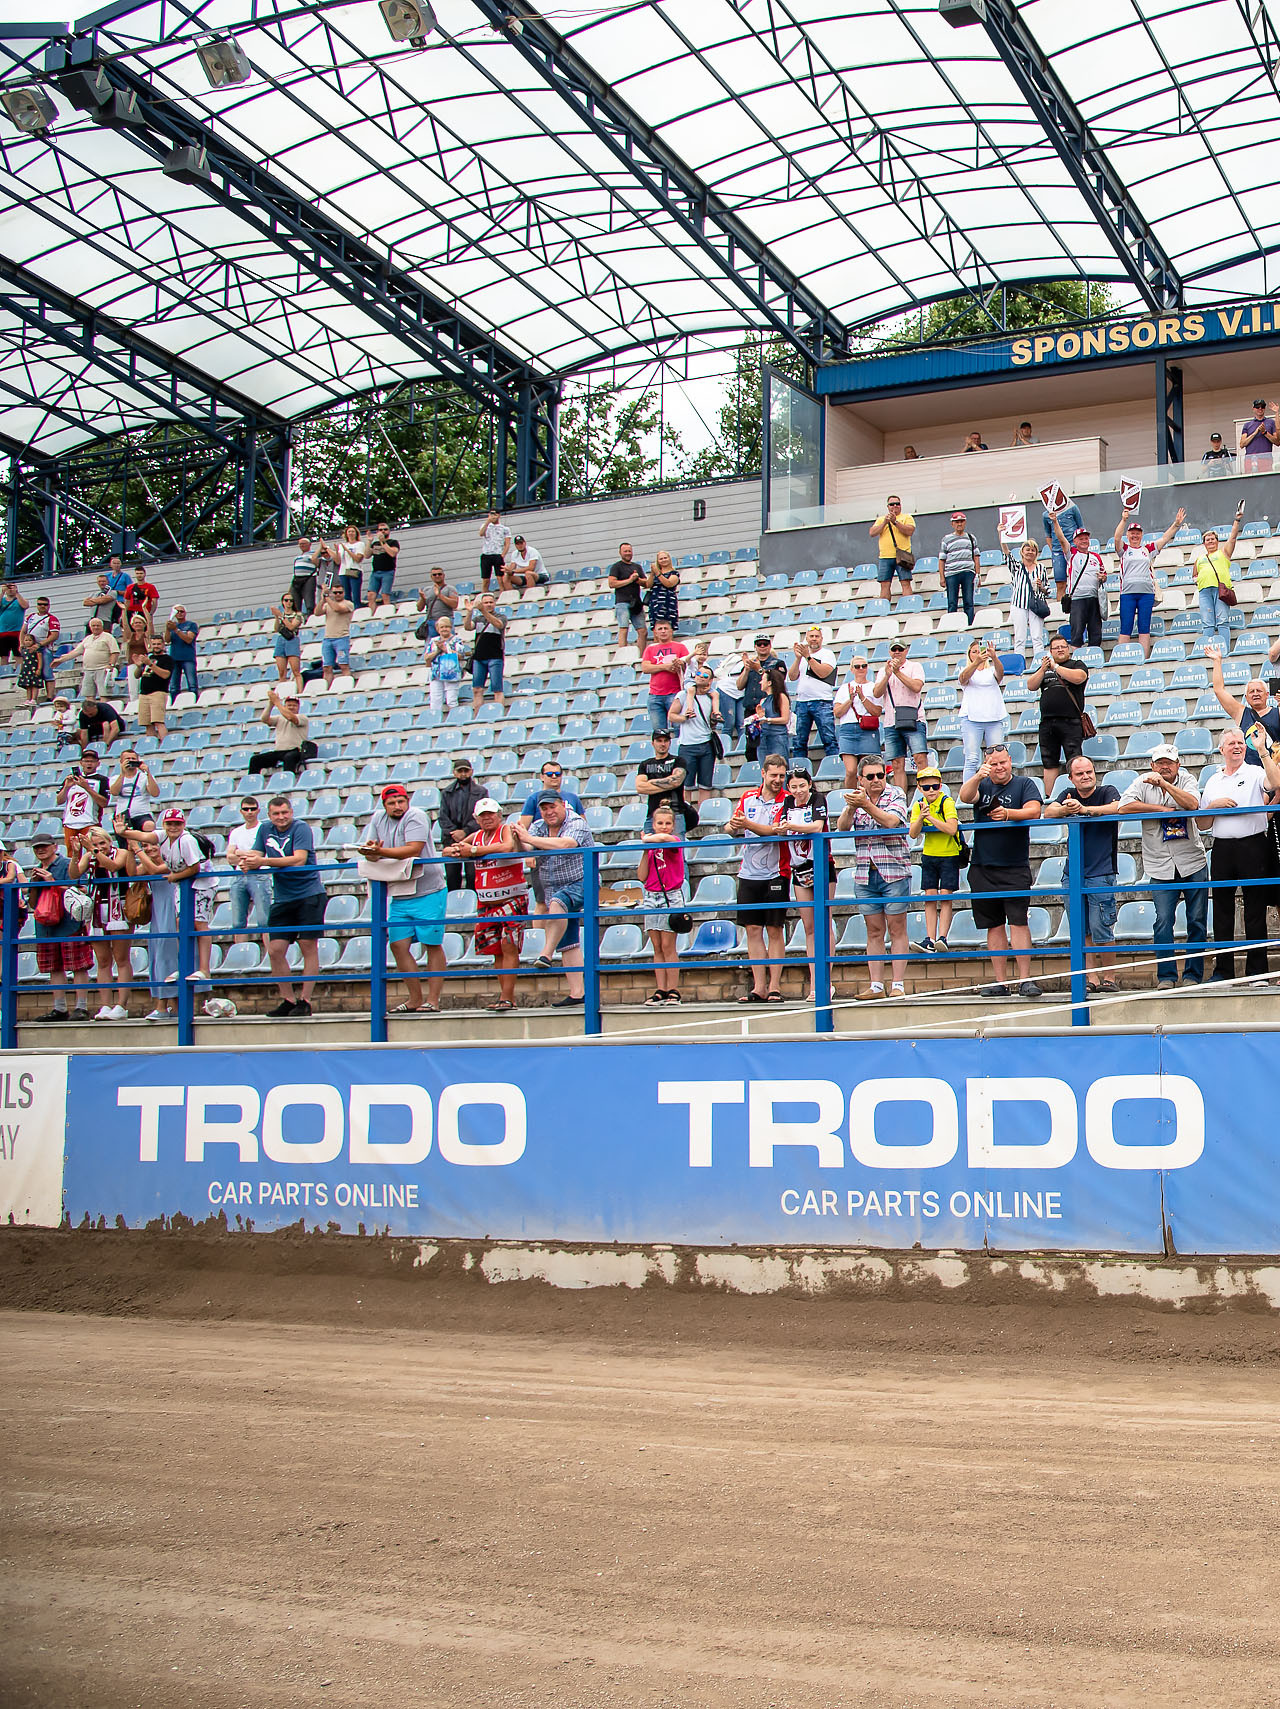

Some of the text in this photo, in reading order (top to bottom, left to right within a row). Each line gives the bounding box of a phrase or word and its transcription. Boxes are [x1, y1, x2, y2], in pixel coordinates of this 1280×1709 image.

[1011, 314, 1206, 366] SPONSORS
[982, 794, 1012, 805] BSS
[117, 1083, 527, 1167] TRODO
[657, 1073, 1206, 1170] TRODO
[208, 1180, 420, 1208] CAR PARTS ONLINE
[780, 1189, 1063, 1219] CAR PARTS ONLINE
